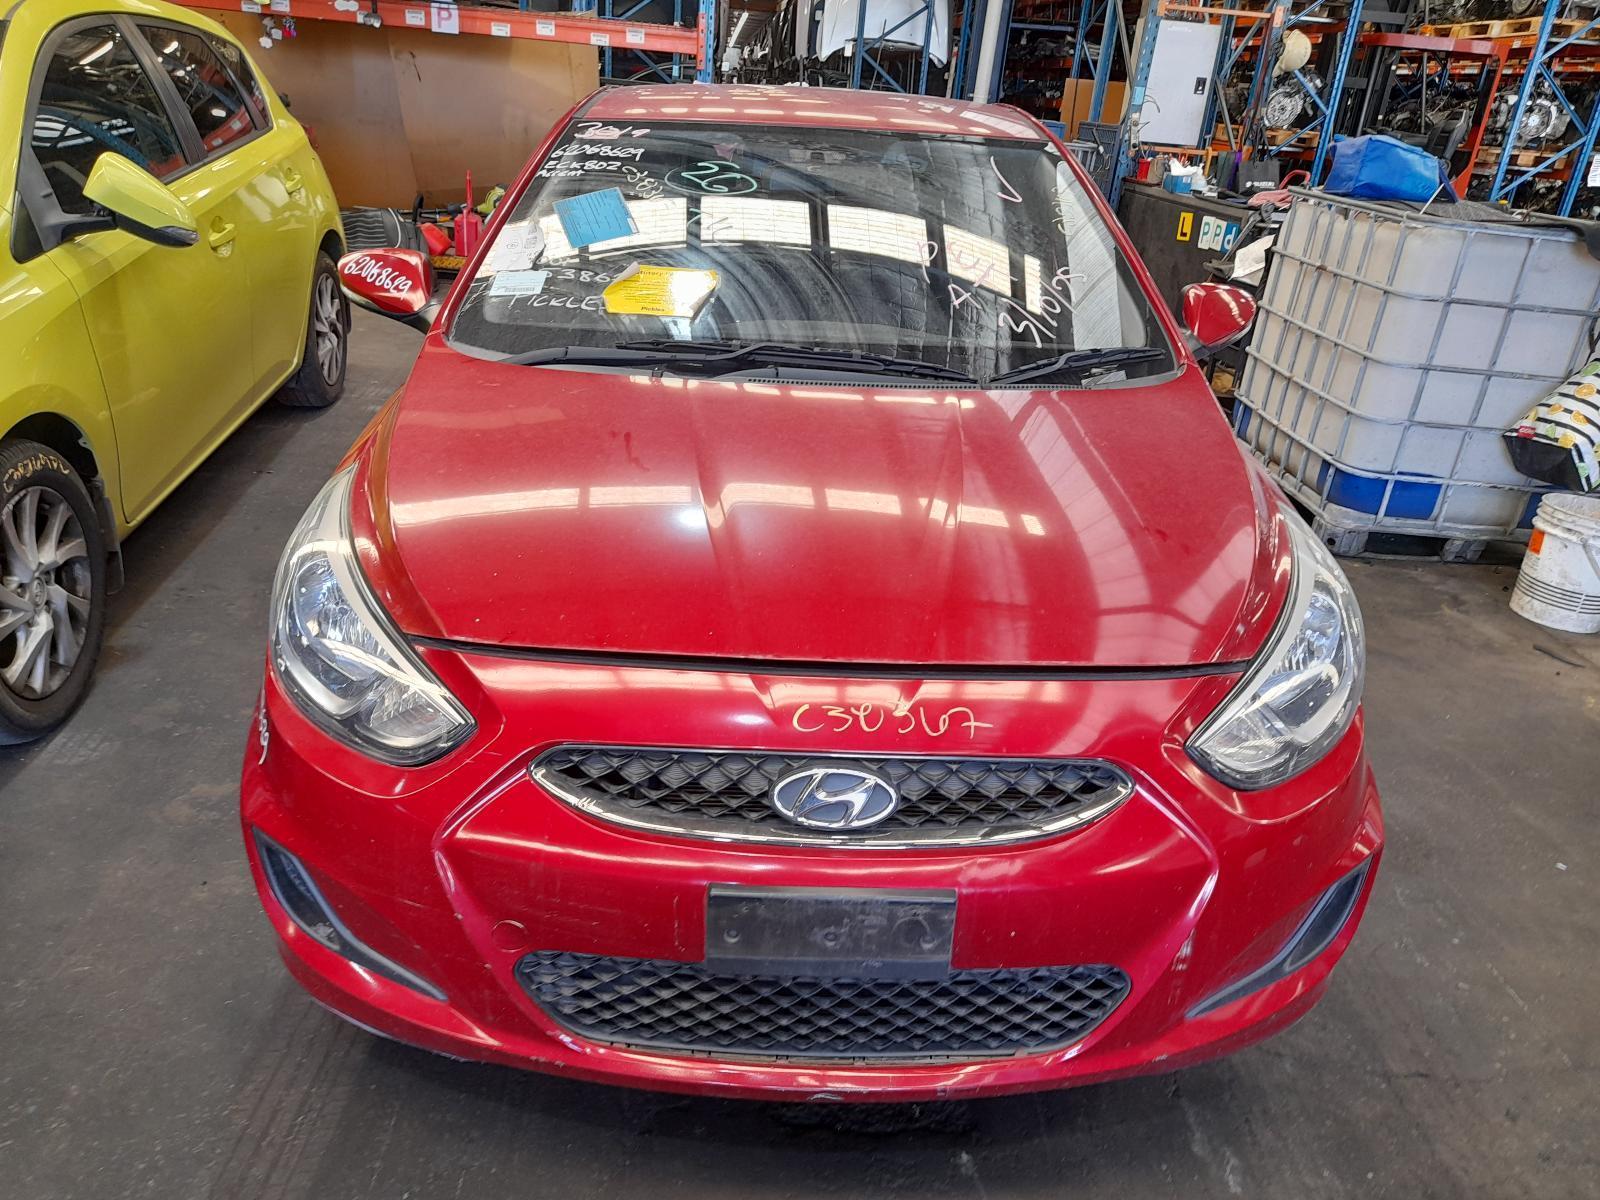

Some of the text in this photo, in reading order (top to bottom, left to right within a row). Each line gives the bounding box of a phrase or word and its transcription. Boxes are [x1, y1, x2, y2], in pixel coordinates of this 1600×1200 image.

[436, 7, 453, 29] P
[1180, 217, 1188, 238] L
[343, 256, 413, 301] 62068629
